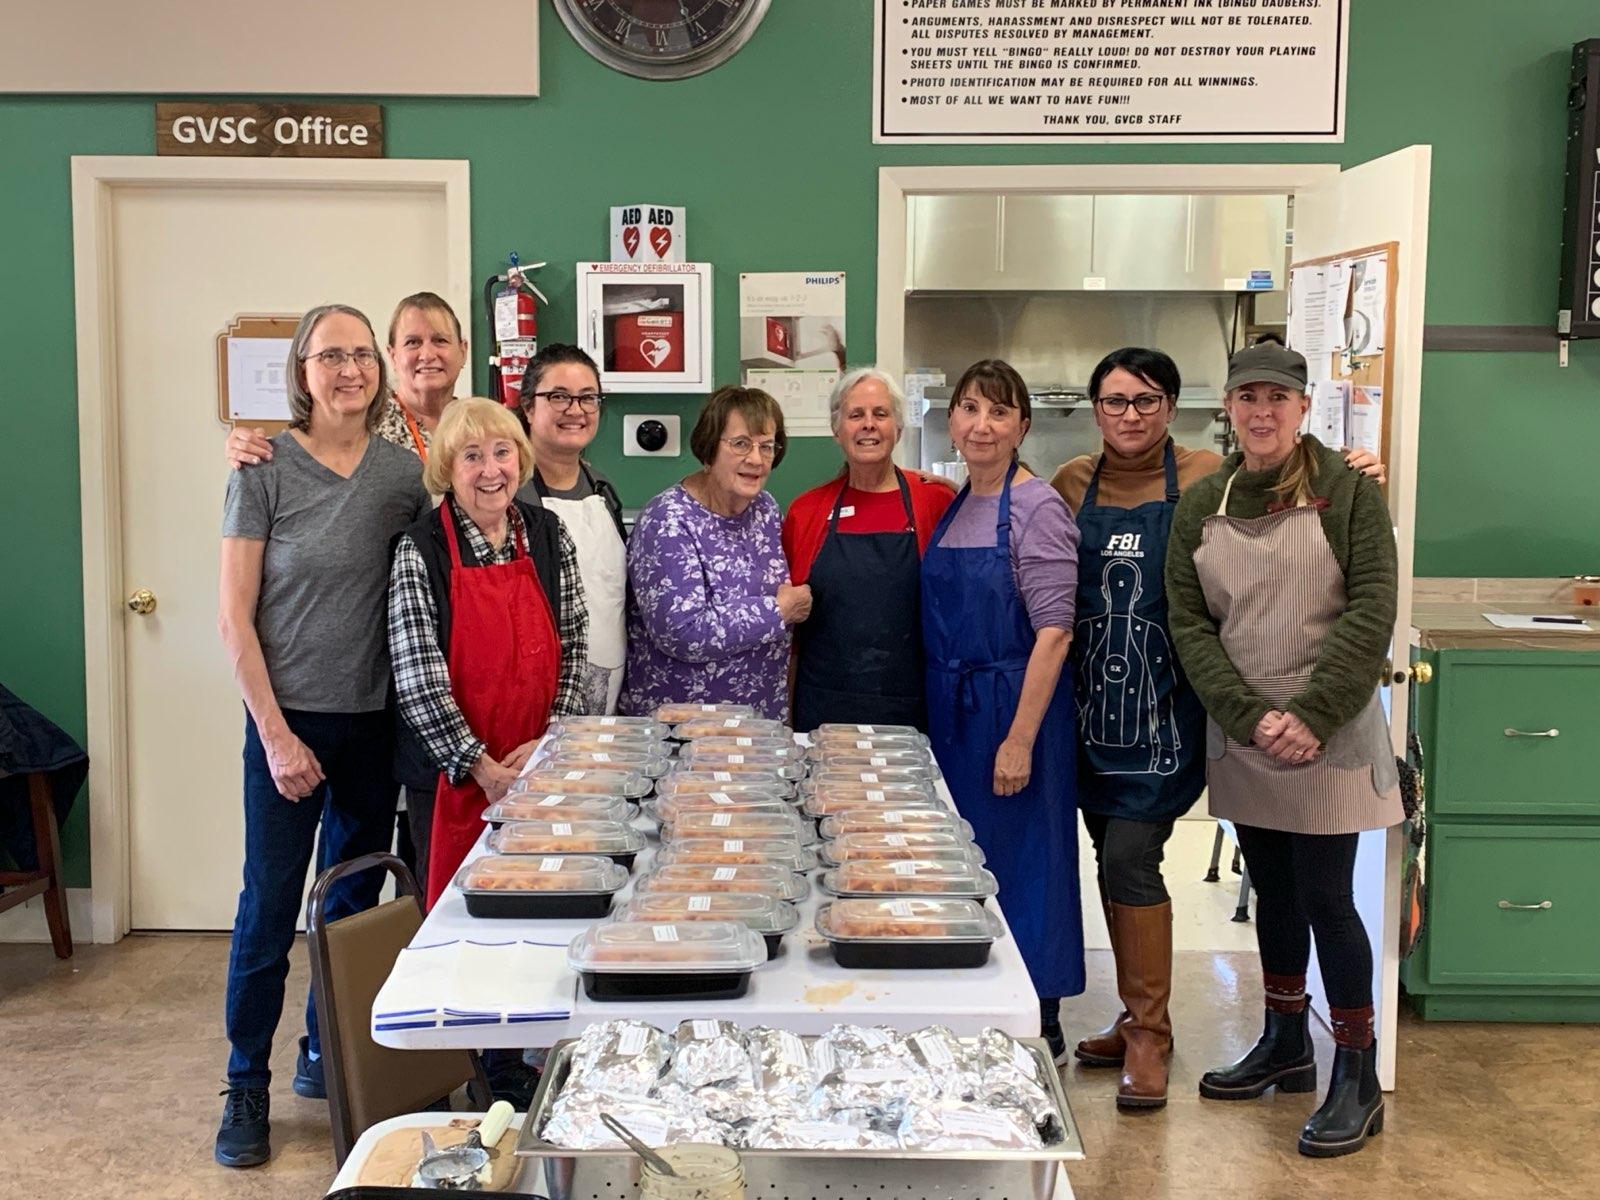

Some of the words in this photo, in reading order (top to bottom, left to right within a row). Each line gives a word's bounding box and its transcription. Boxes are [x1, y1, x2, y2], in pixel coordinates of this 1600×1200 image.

[911, 16, 983, 26] ARGUMENTS,
[988, 16, 1065, 26] HARASSMENT
[1069, 16, 1093, 26] AND
[1097, 16, 1166, 26] DISRESPECT
[1170, 16, 1196, 26] WILL
[1201, 16, 1223, 26] NOT
[1227, 16, 1241, 26] BE
[1247, 16, 1312, 26] TOLERATED.
[911, 29, 930, 39] ALL
[935, 29, 989, 39] DISPUTES
[993, 29, 1049, 39] RESOLVED
[1053, 29, 1068, 39] BY
[1072, 29, 1154, 39] MANAGEMENT.
[910, 47, 932, 57] YOU
[936, 47, 968, 57] MUST
[973, 47, 998, 57] YELL
[1053, 47, 1094, 57] REALLY
[1097, 47, 1130, 57] LOUD!
[1134, 47, 1150, 57] DO
[1154, 47, 1177, 57] NOT
[1180, 47, 1231, 57] DESTROY
[1236, 47, 1265, 57] YOUR
[1269, 47, 1316, 57] PLAYING
[910, 59, 953, 69] SHEETS
[957, 59, 988, 69] UNTIL
[993, 59, 1013, 69] THE
[1018, 59, 1053, 69] BINGO
[1057, 59, 1069, 69] IS
[1073, 59, 1141, 69] CONFIRMED.
[910, 77, 946, 87] PHOTO
[950, 77, 1037, 87] IDENTIFICATION
[1040, 77, 1065, 87] MAY
[1069, 77, 1083, 87] BE
[1088, 77, 1143, 88] REQUIRED
[1147, 77, 1169, 87] FOR
[1173, 77, 1192, 87] ALL
[1198, 77, 1258, 87] WINNINGS.
[909, 95, 941, 105] MOST
[945, 95, 959, 105] OF
[963, 95, 983, 105] ALL
[988, 95, 1004, 105] WE
[1010, 95, 1042, 105] WANT
[1046, 95, 1060, 105] TO
[1064, 95, 1093, 105] HAVE
[1097, 95, 1130, 105] FUN!!!
[1043, 115, 1080, 125] THANK
[1085, 115, 1110, 125] YOU,
[1114, 115, 1143, 125] GVCB
[1148, 115, 1182, 125] STAFF
[172, 116, 257, 144] GVSC
[274, 116, 368, 145] Office
[621, 208, 642, 225] AED
[648, 208, 674, 226] AED
[600, 264, 641, 273] EMERGENCY
[643, 264, 696, 273] DEFIBRILLATOR
[805, 277, 840, 285] PHILIPS
[1107, 533, 1141, 551] FBI
